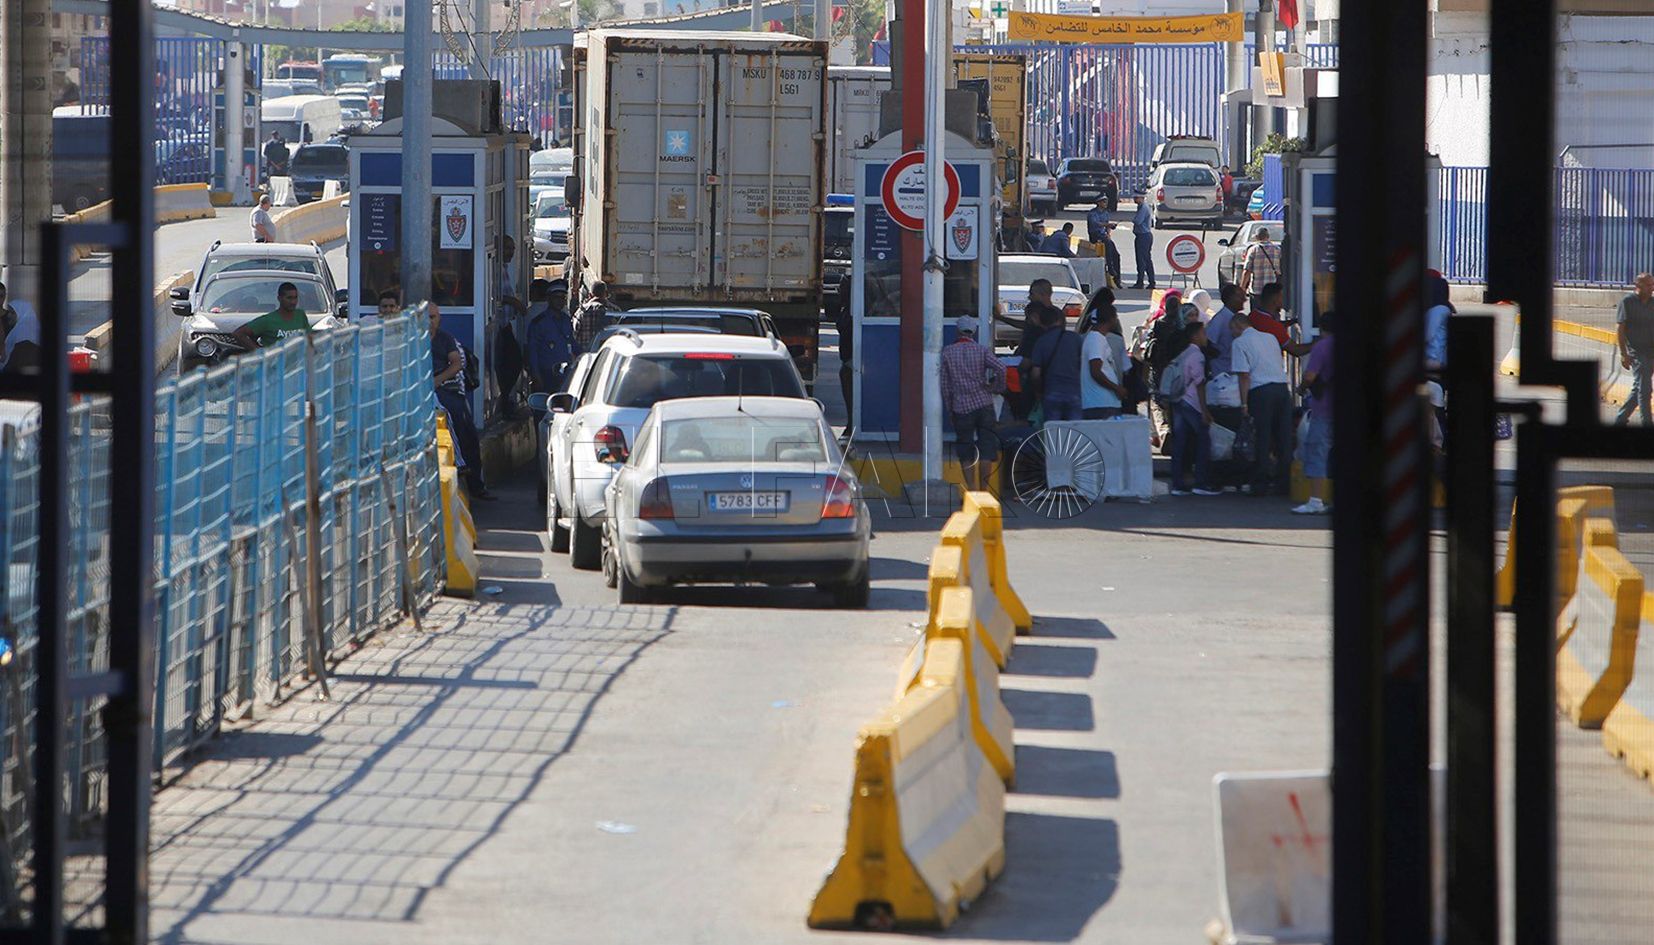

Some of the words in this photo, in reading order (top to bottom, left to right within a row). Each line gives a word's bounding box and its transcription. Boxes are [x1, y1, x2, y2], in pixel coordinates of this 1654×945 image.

[1046, 22, 1088, 34] للتضامن
[1092, 22, 1130, 35] الخامس
[1136, 25, 1161, 33] محمد
[1166, 20, 1204, 35] مؤسسة
[742, 68, 767, 79] MSKU
[797, 70, 812, 80] 787
[719, 495, 752, 508] 5783
